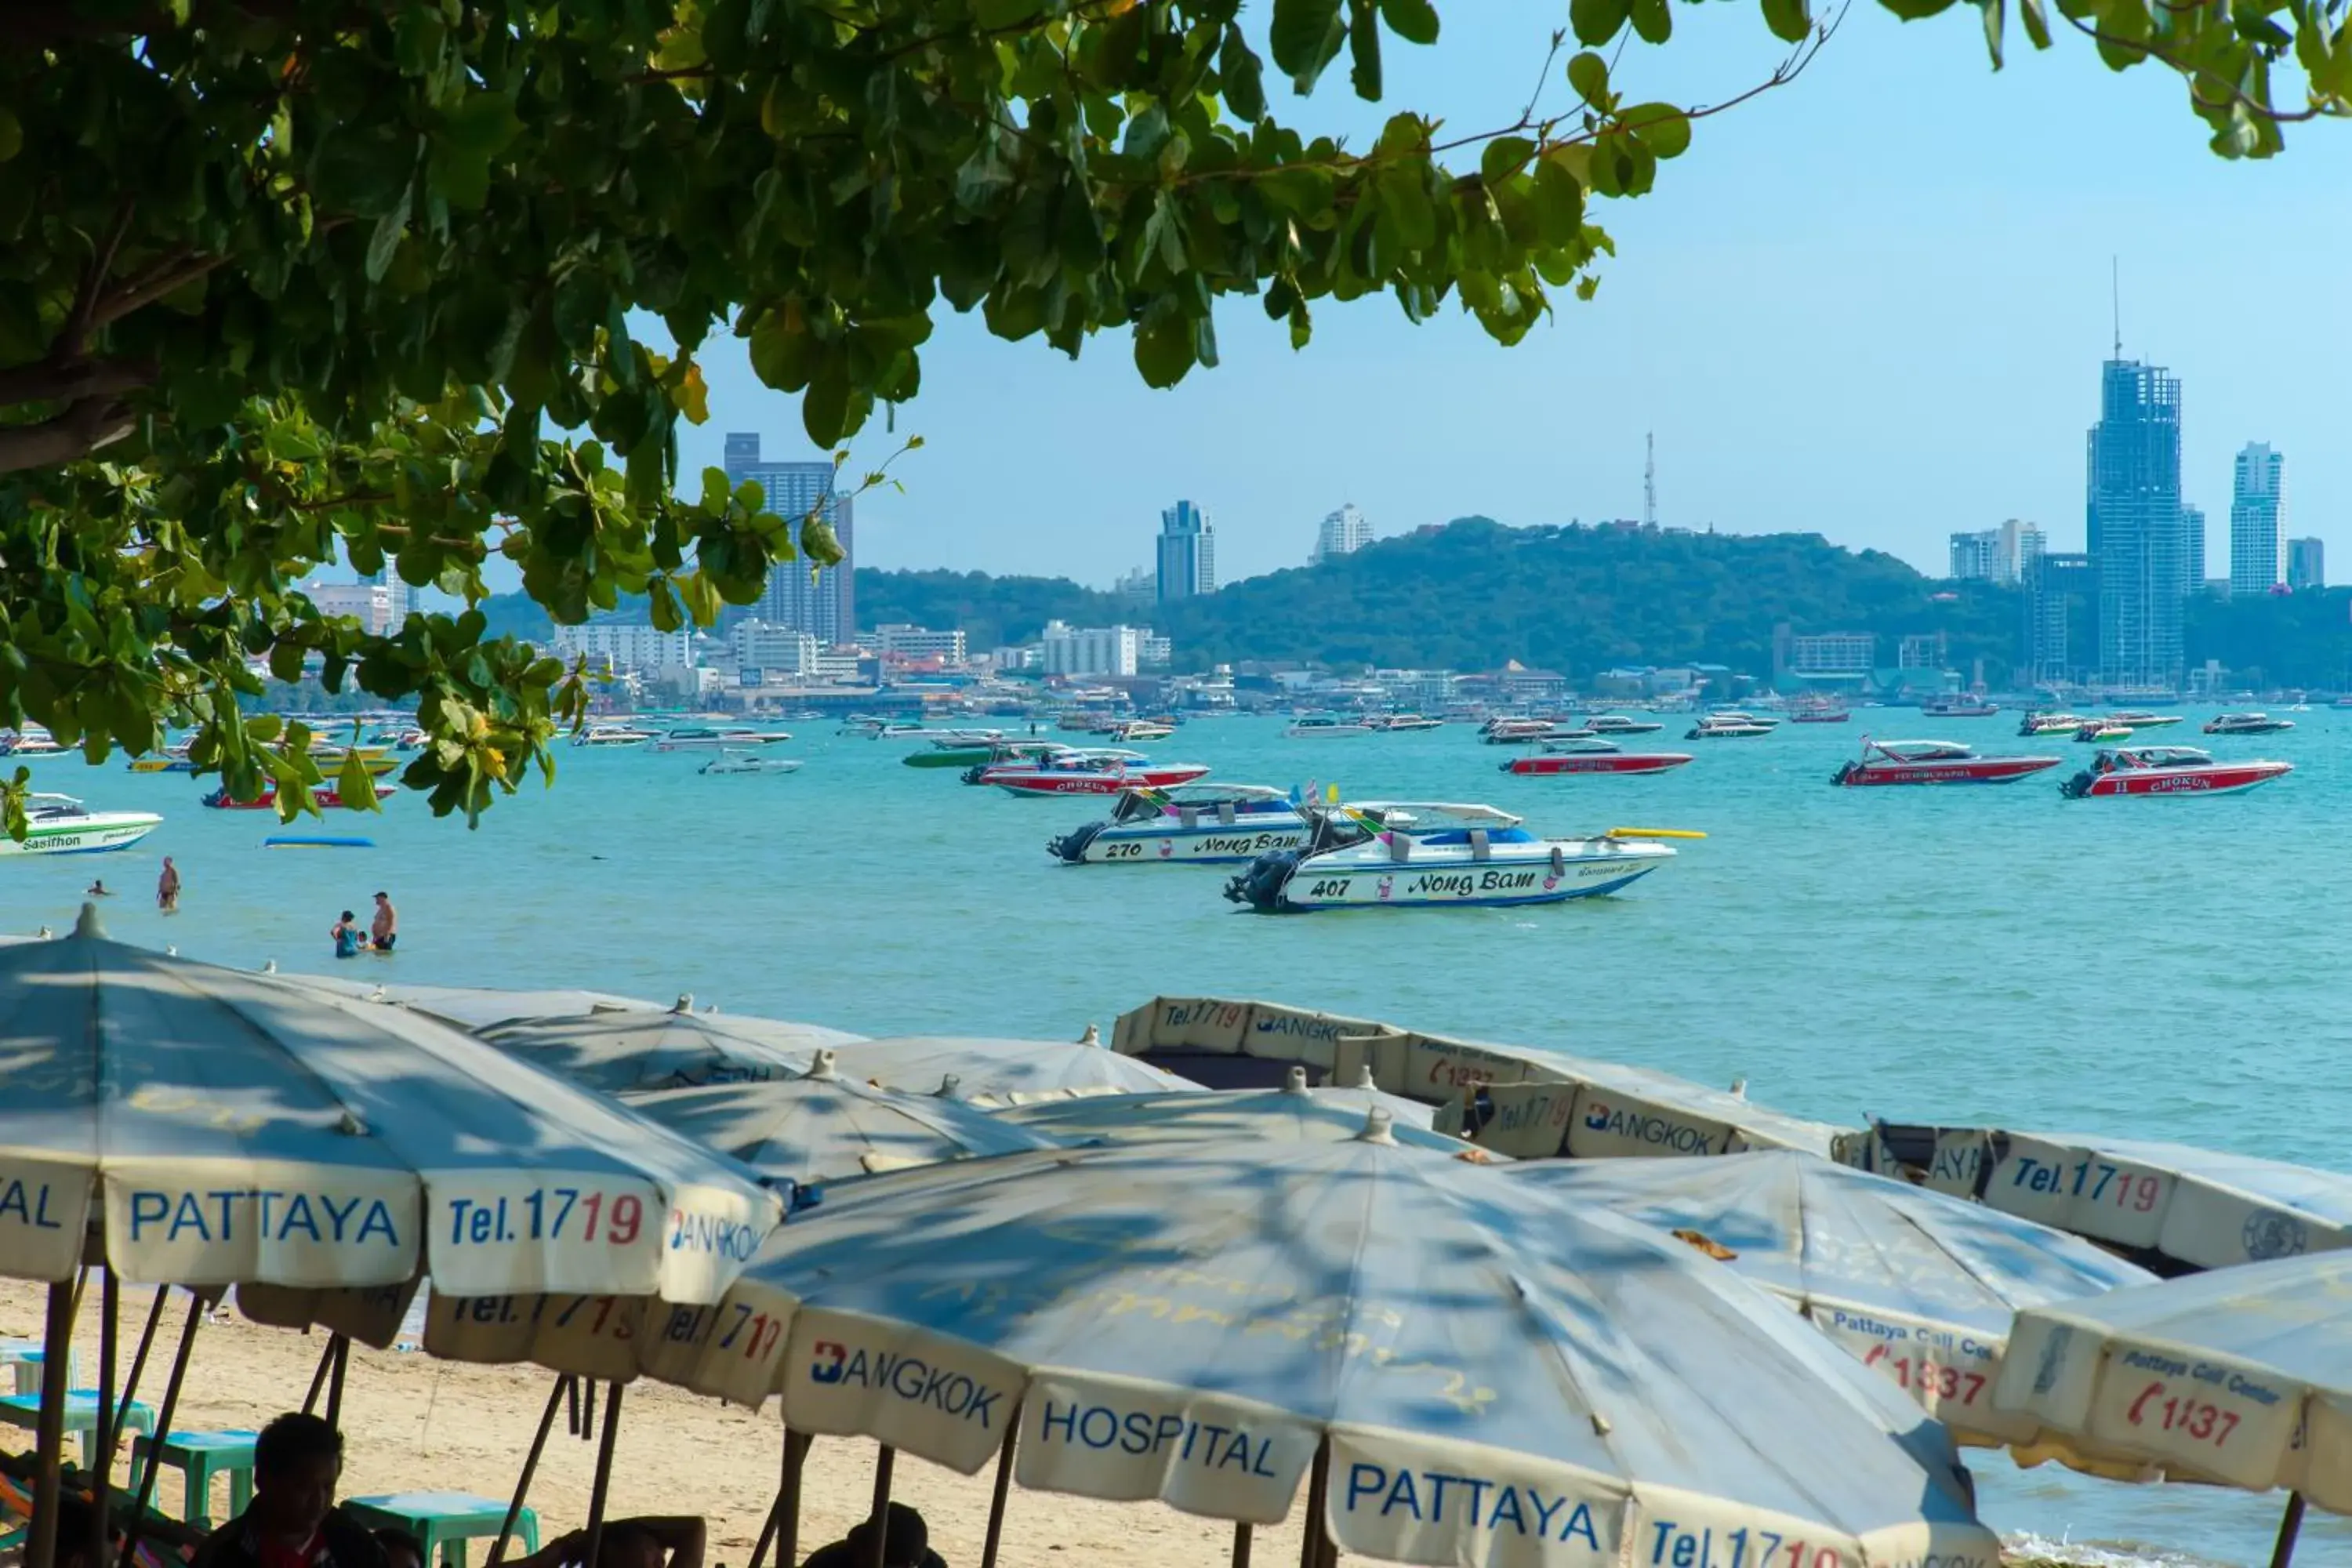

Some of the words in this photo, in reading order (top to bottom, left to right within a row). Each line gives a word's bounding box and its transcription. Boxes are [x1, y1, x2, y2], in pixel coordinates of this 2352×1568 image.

[2150, 776, 2211, 791] CHOKUN
[1105, 842, 1142, 858] 270
[1194, 837, 1253, 853] Nong
[1310, 879, 1351, 897] 407
[1408, 876, 1475, 895] Nong
[1478, 870, 1537, 891] Bam
[1165, 998, 1240, 1028] Tel.1719
[1584, 1103, 1714, 1156] BANGKOK
[2012, 1156, 2160, 1213] Tel.1719
[129, 1189, 400, 1247] PATTAYA
[448, 1189, 644, 1246] Tel.1719
[1833, 1311, 1908, 1341] Pattaya
[811, 1340, 1004, 1430] BANGKOK
[1894, 1356, 1987, 1406] 1337
[1042, 1402, 1276, 1479] HOSPITAL
[1346, 1463, 1601, 1552] PATTAYA
